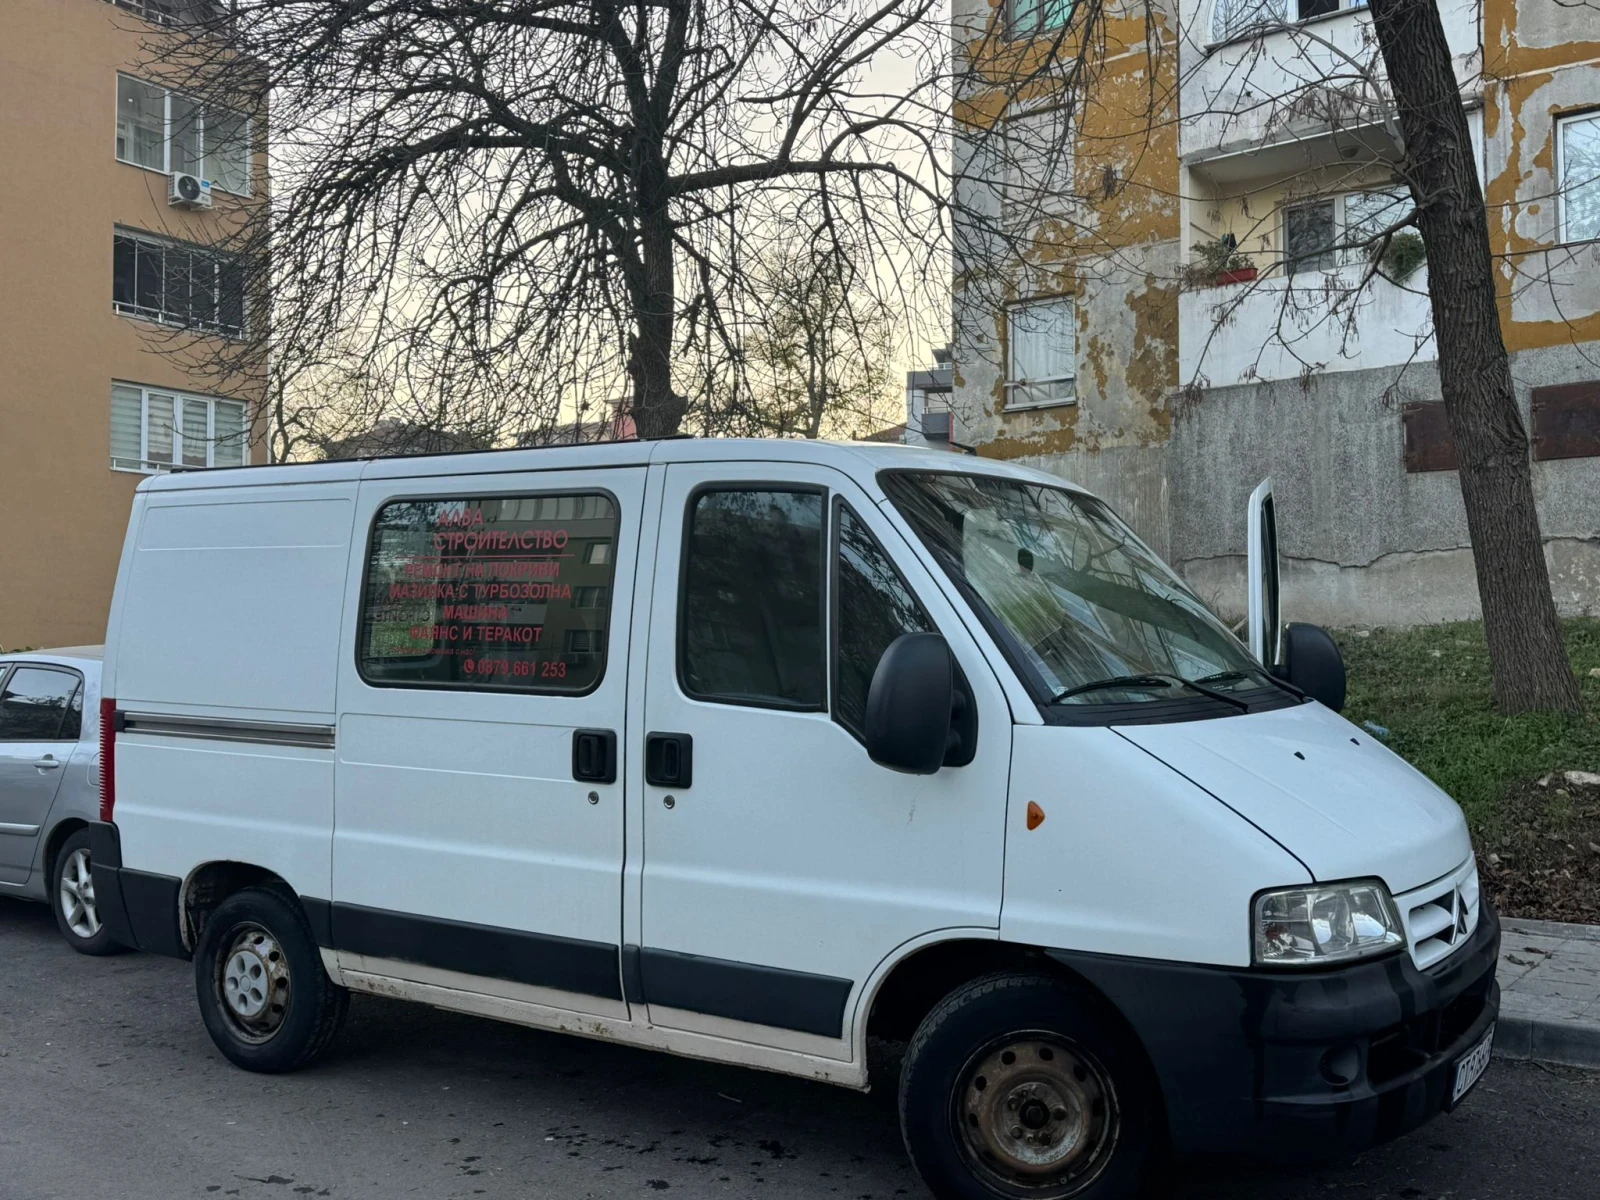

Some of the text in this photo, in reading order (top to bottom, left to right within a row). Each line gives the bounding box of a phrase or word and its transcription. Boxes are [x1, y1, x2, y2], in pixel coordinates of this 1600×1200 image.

[434, 529, 570, 551] СТРОИТЕЛСТВО
[405, 561, 560, 579] РЕМОНТ НА ПОКРИВИ
[389, 583, 572, 599] МАЗИЛКА С ТУРБОЗОЛНА
[442, 604, 509, 620] МАШИНА
[409, 625, 543, 642] ФАЯНС И ТЕРАКОТ
[477, 659, 566, 677] 0879 661 253
